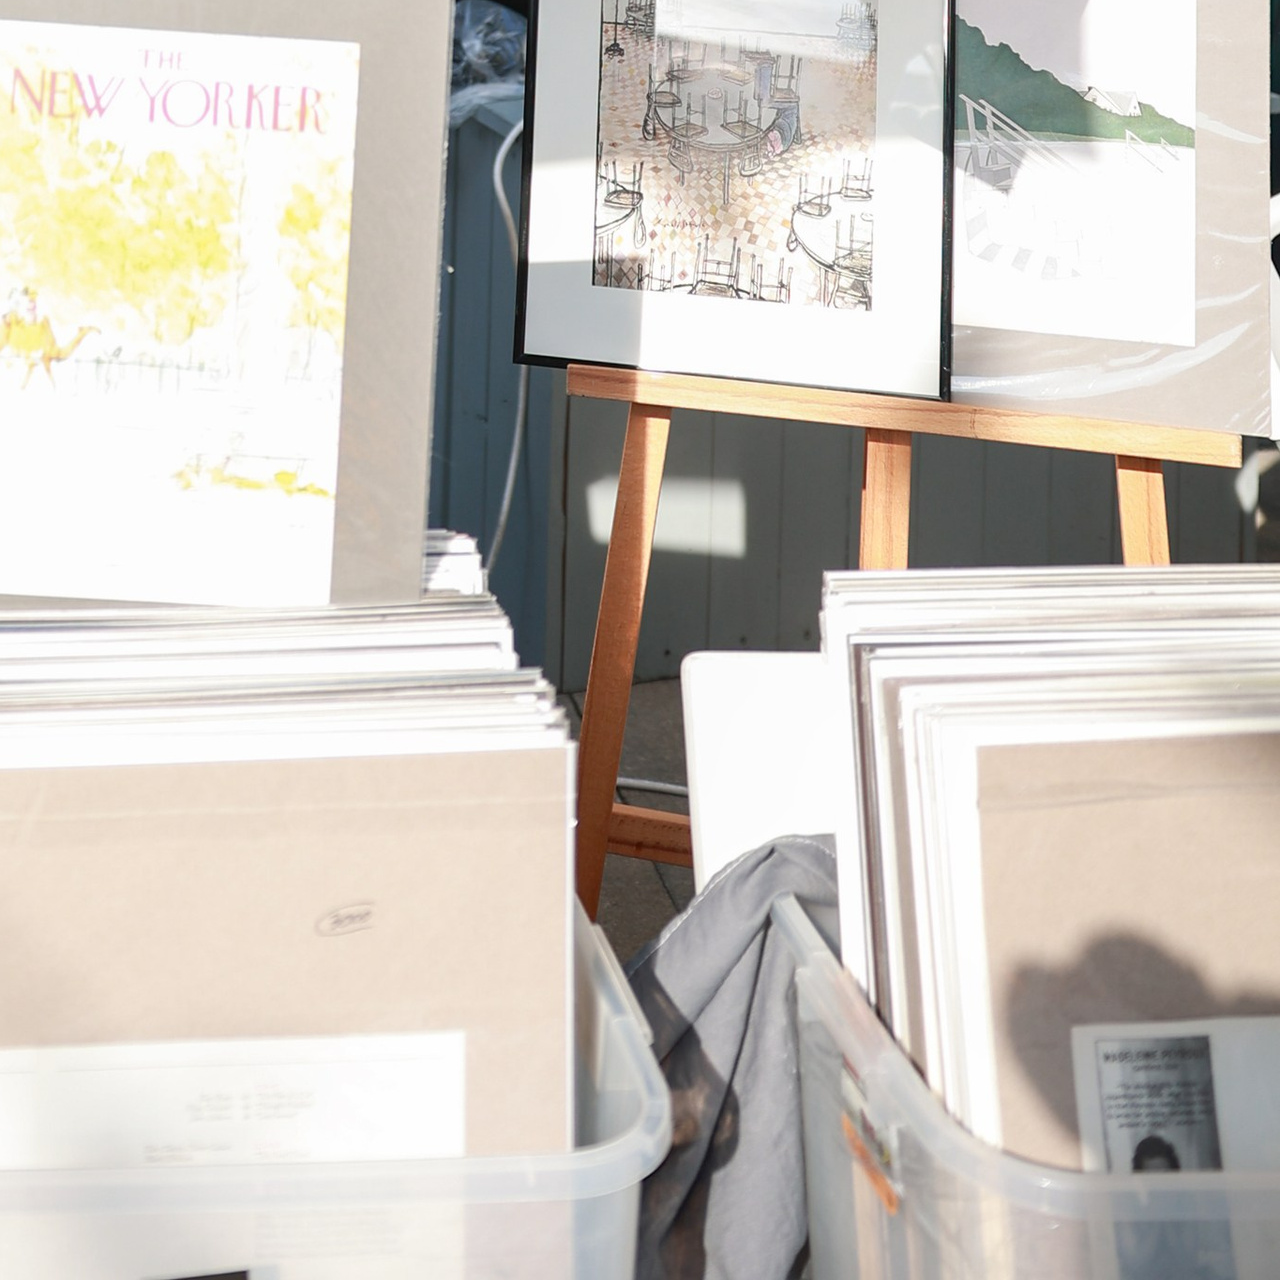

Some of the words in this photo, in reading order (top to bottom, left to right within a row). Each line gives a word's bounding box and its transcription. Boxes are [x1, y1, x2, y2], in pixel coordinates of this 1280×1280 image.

[138, 48, 186, 71] THE
[10, 66, 125, 119] NEW
[138, 76, 328, 135] YORKER
